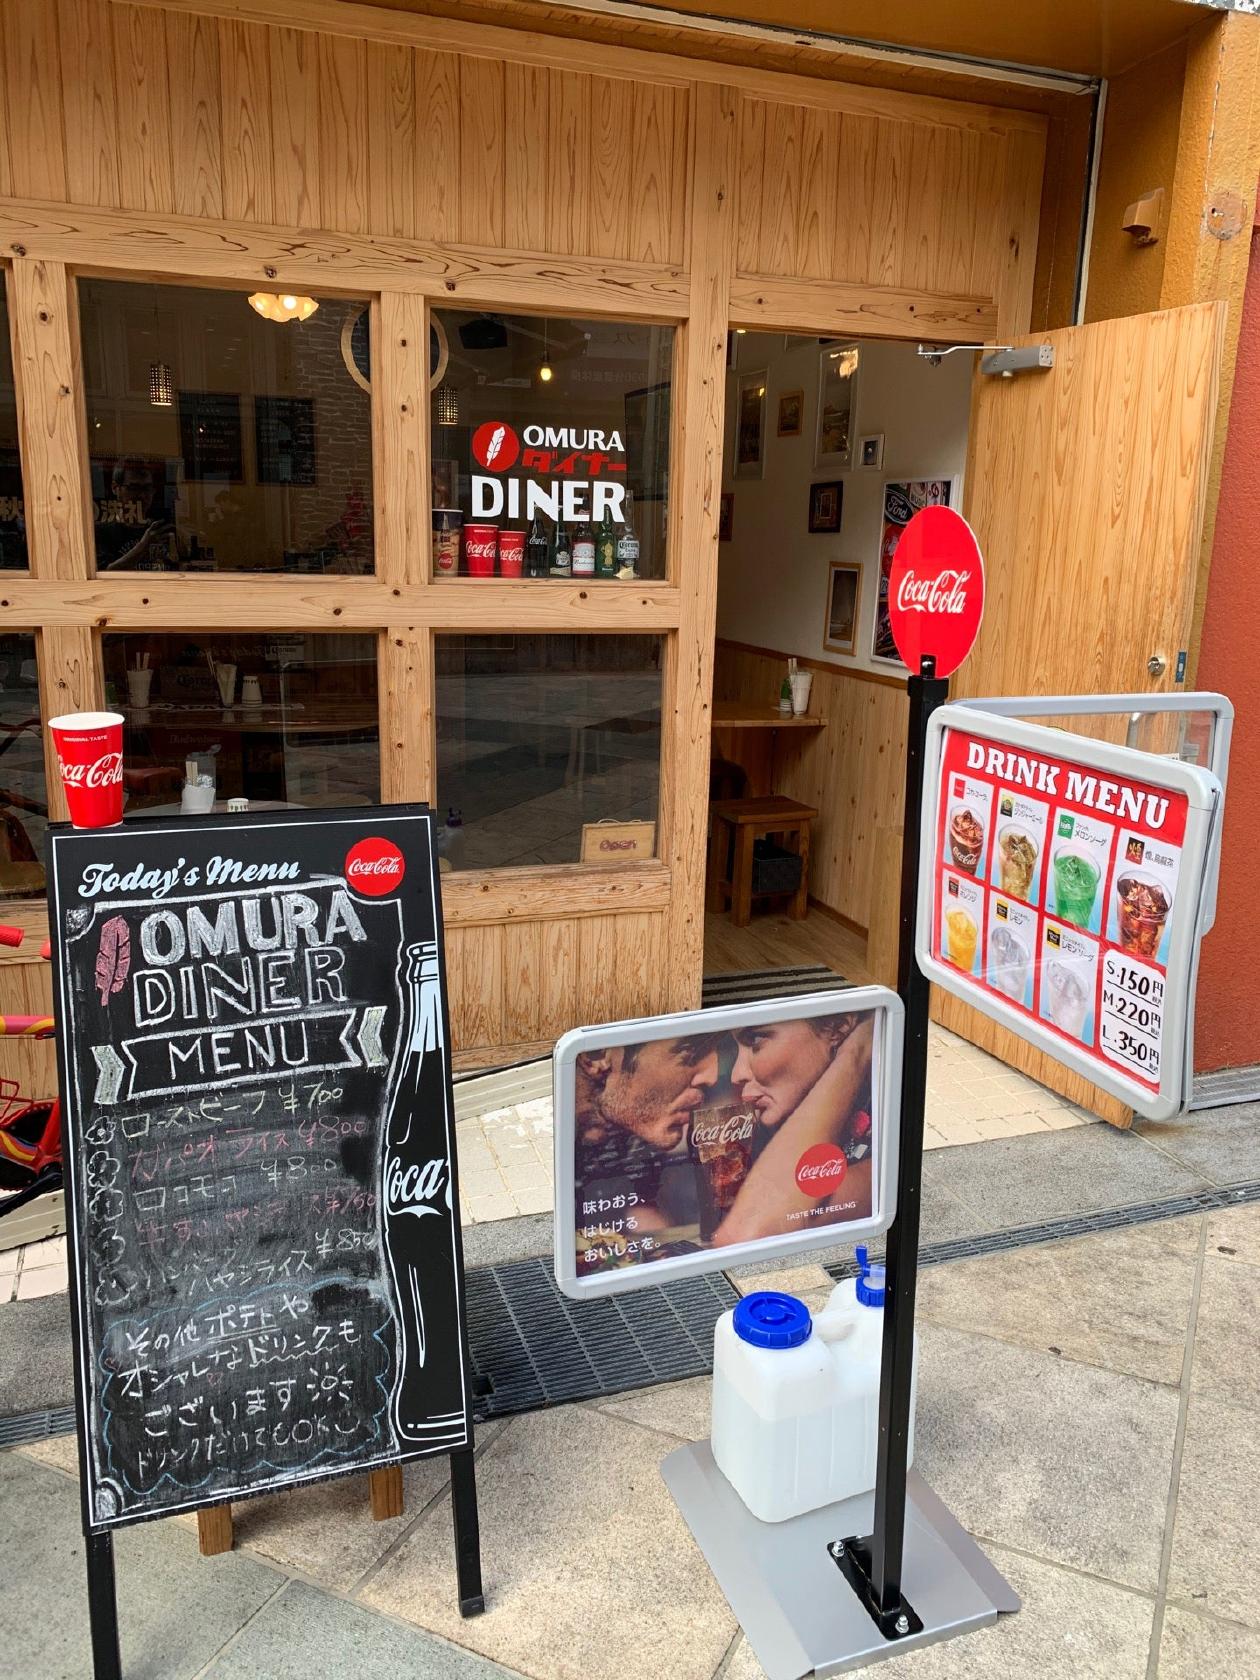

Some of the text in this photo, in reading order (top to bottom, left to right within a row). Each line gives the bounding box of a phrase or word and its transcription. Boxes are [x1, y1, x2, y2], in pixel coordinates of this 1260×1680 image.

[523, 425, 625, 451] OMURA
[522, 449, 627, 475] ダイナー
[471, 475, 626, 523] DINER
[887, 496, 908, 520] Ford
[897, 570, 972, 614] Coca-Cola
[966, 741, 1170, 829] DRINK MENU
[78, 855, 300, 898] Today's Menu
[348, 856, 402, 876] Coca-Cola
[140, 890, 368, 966] OMURA
[132, 946, 348, 1027] DINER
[168, 1022, 309, 1080] MENU
[121, 1081, 344, 1138] ローストビーフ ¥700
[691, 1112, 754, 1147] Coca-Cola
[298, 1115, 367, 1149] ¥800
[134, 1156, 338, 1212] ロコモコ ¥800
[797, 1158, 844, 1181] Coca-Cola
[582, 1192, 646, 1215] 味わおう、
[786, 1201, 857, 1221] TASTE THE FEELING
[583, 1216, 639, 1239] はじける
[584, 1237, 661, 1263] おいしさを。
[188, 1249, 314, 1297] ハヤシライス
[124, 1293, 309, 1358] その他ポテトや
[117, 1318, 362, 1398] オシャレなドリンクも
[144, 1377, 297, 1437] ございます
